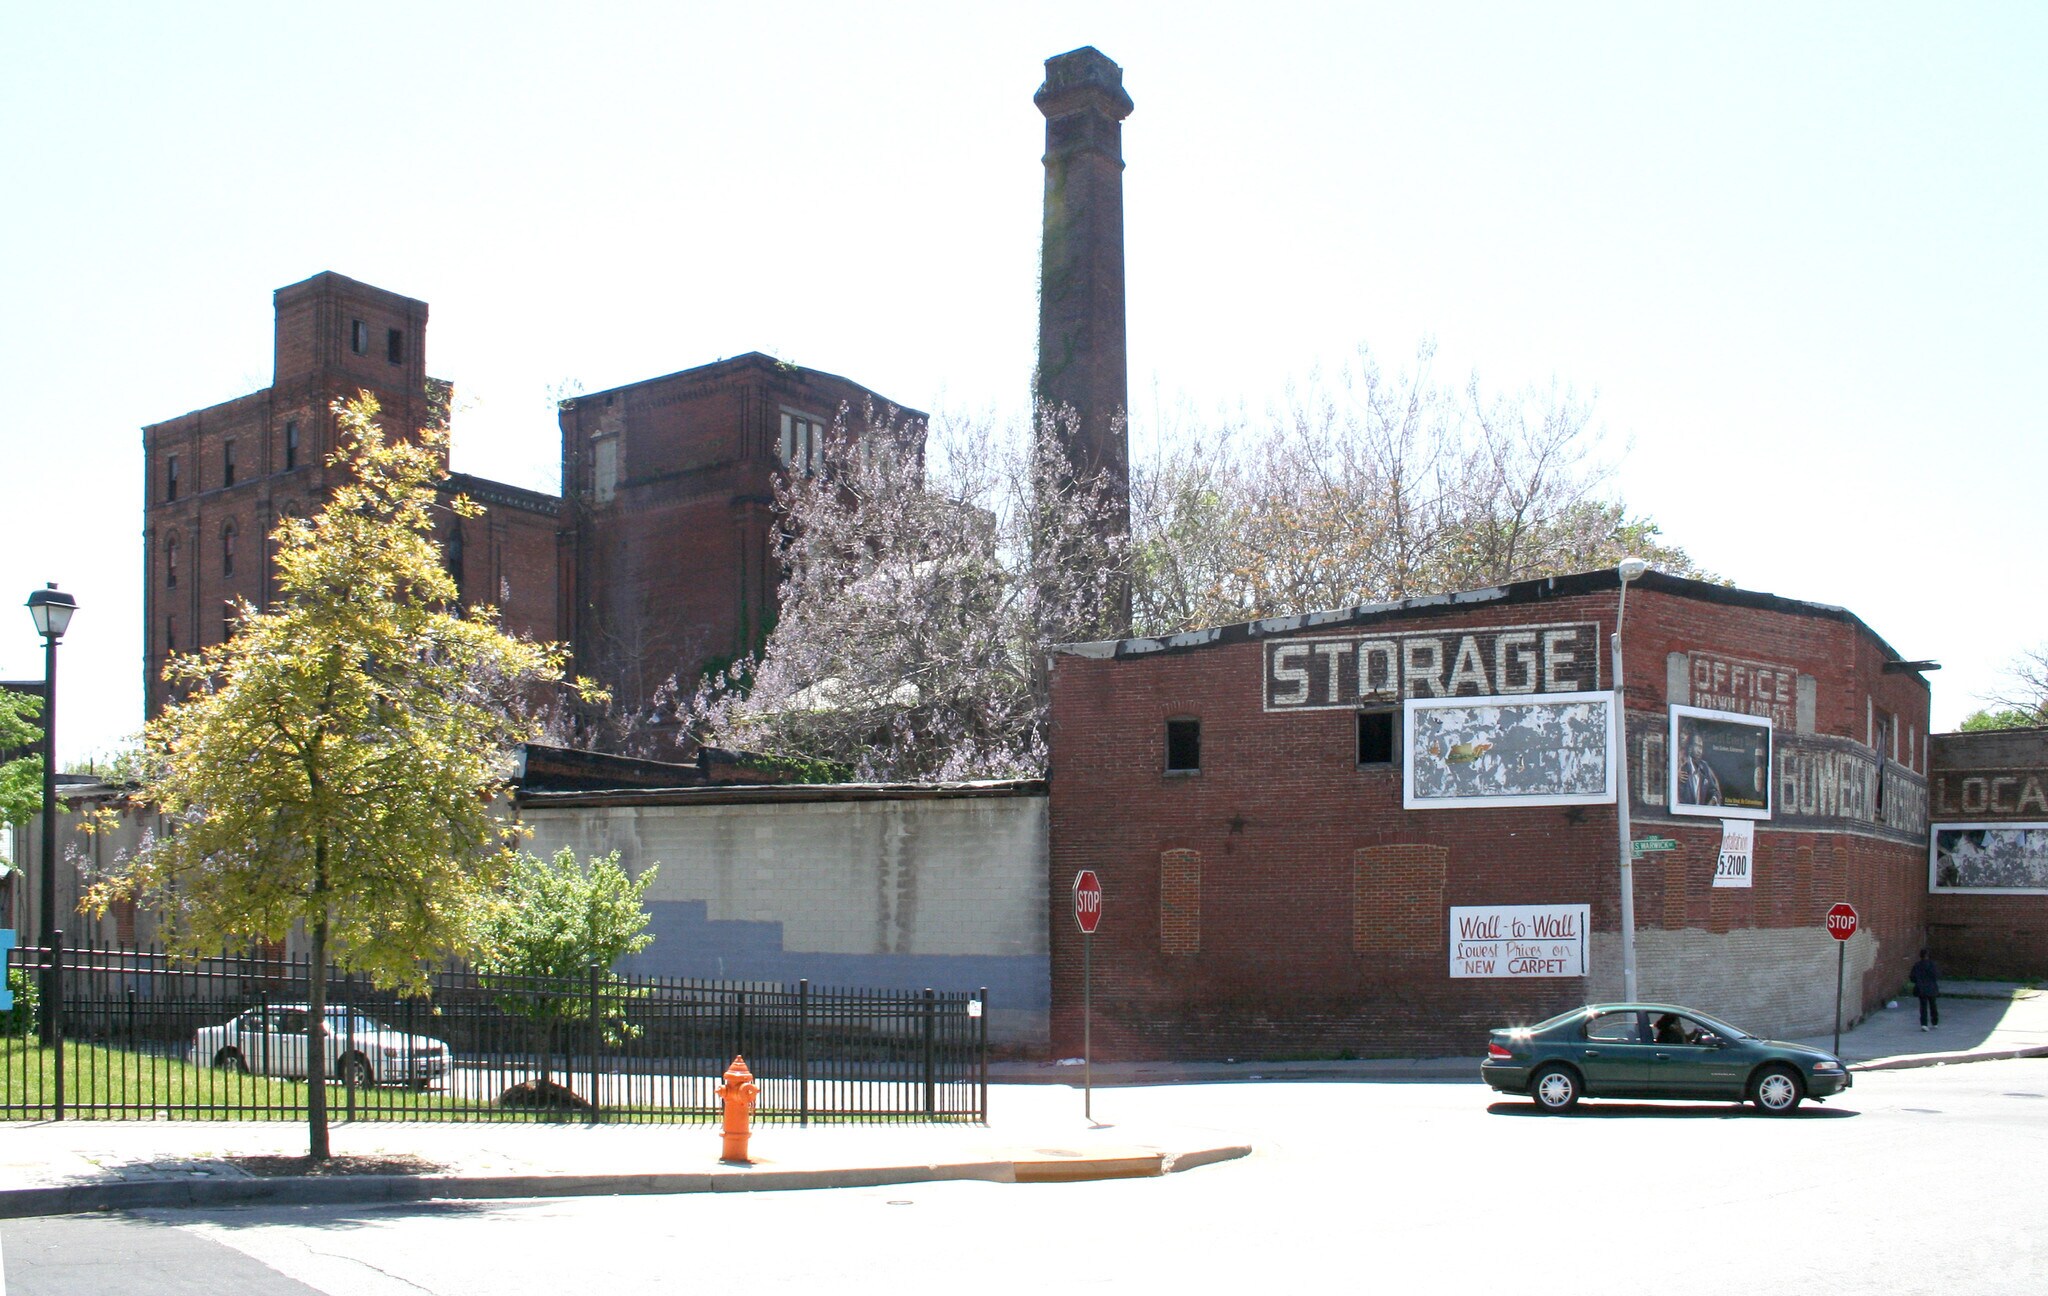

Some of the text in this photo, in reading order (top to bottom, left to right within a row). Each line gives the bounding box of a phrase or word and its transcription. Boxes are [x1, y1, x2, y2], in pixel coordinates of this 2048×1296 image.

[1273, 630, 1579, 705] STORAGE
[1694, 660, 1789, 702] OFFICE
[1078, 890, 1100, 912] STOP
[1829, 915, 1855, 929] STOP
[1456, 941, 1574, 959] Lowest Prices on
[1465, 959, 1566, 974] NEW CARPET
